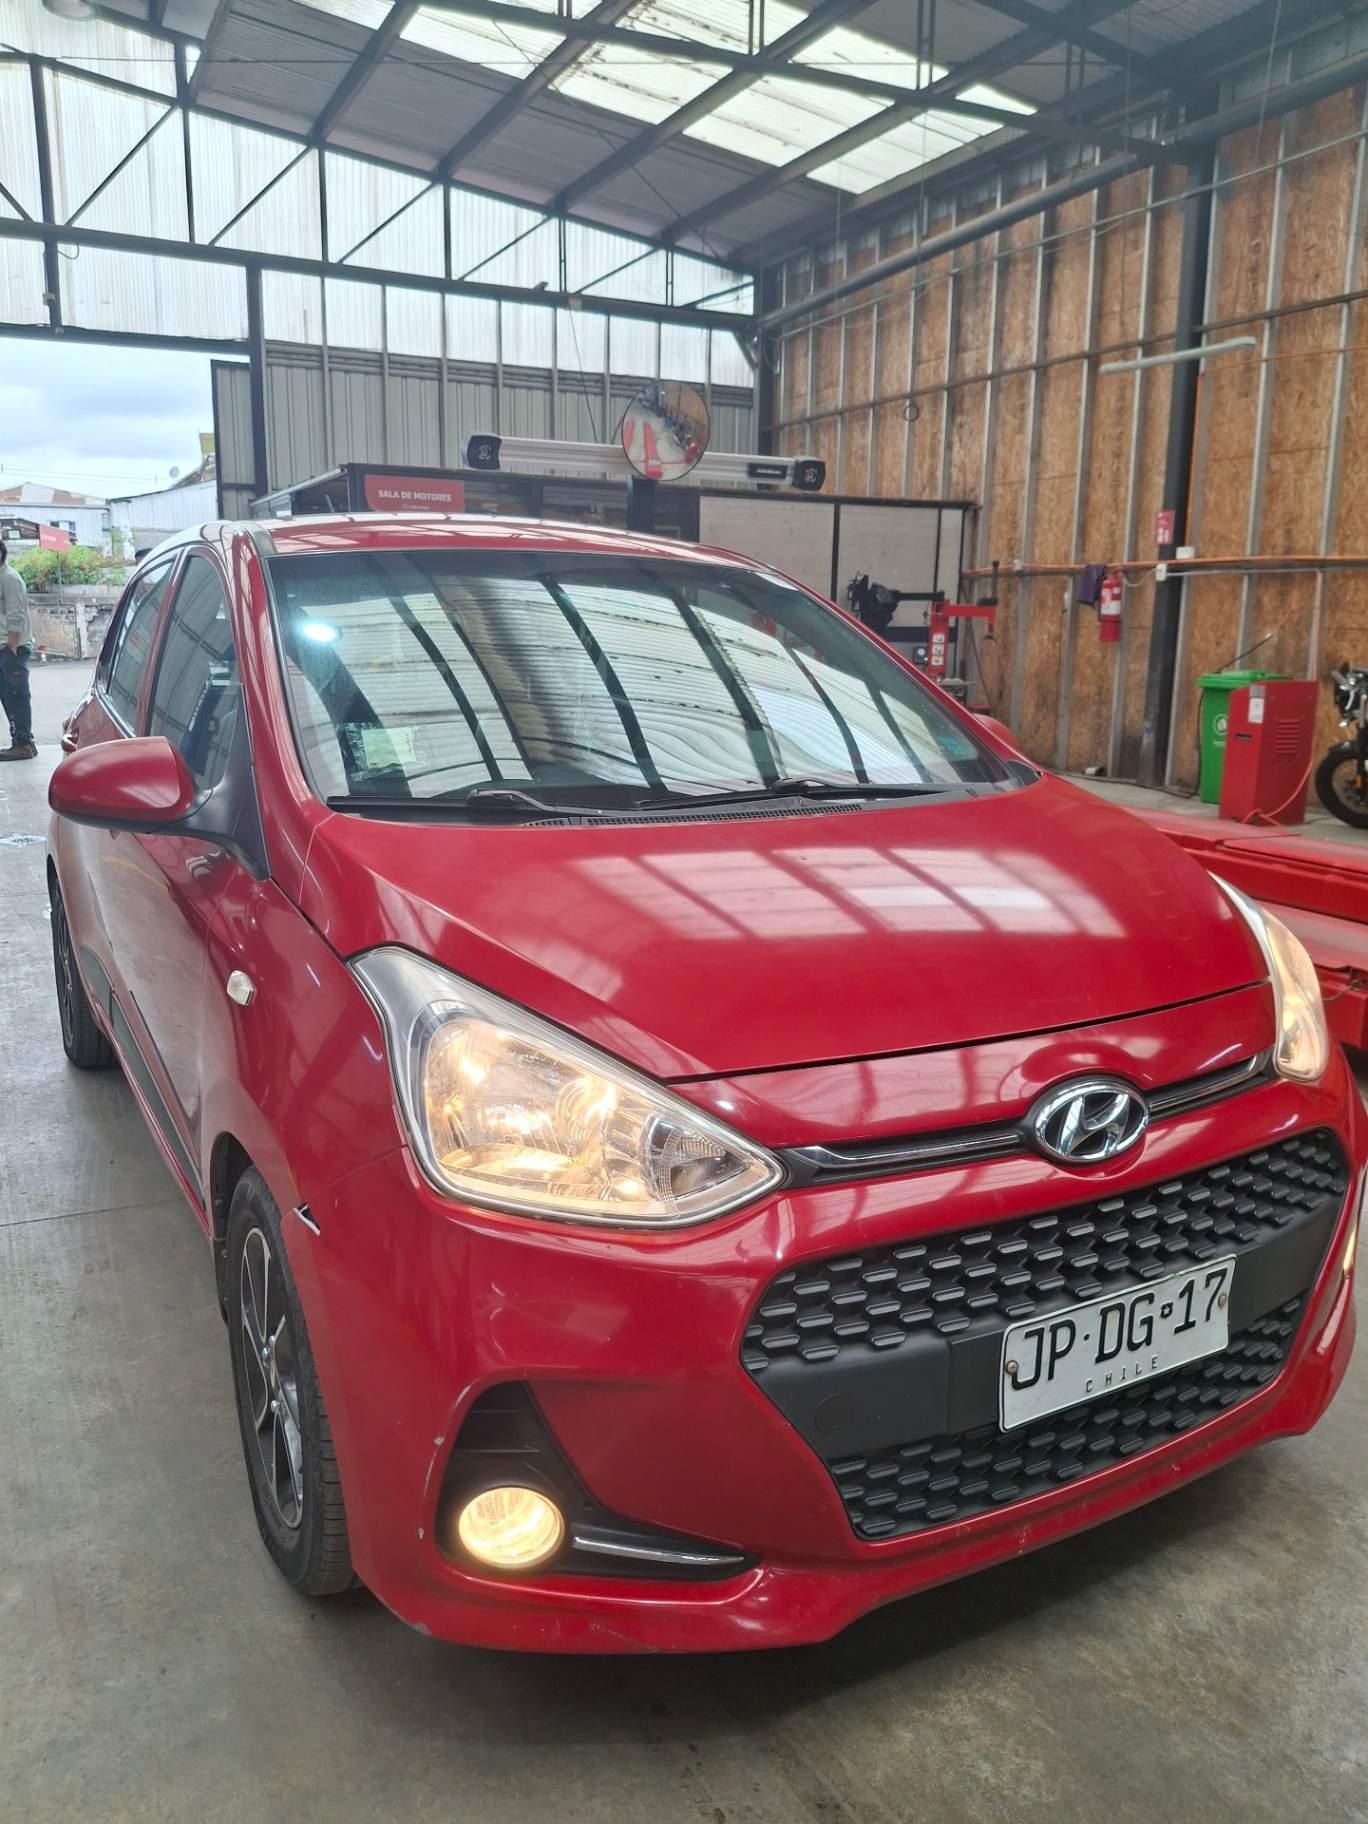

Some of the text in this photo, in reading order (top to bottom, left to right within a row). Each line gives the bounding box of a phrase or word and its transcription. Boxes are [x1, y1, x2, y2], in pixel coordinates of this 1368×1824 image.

[378, 489, 452, 502] SALA DE MOTORES
[1085, 1354, 1160, 1393] CHILE
